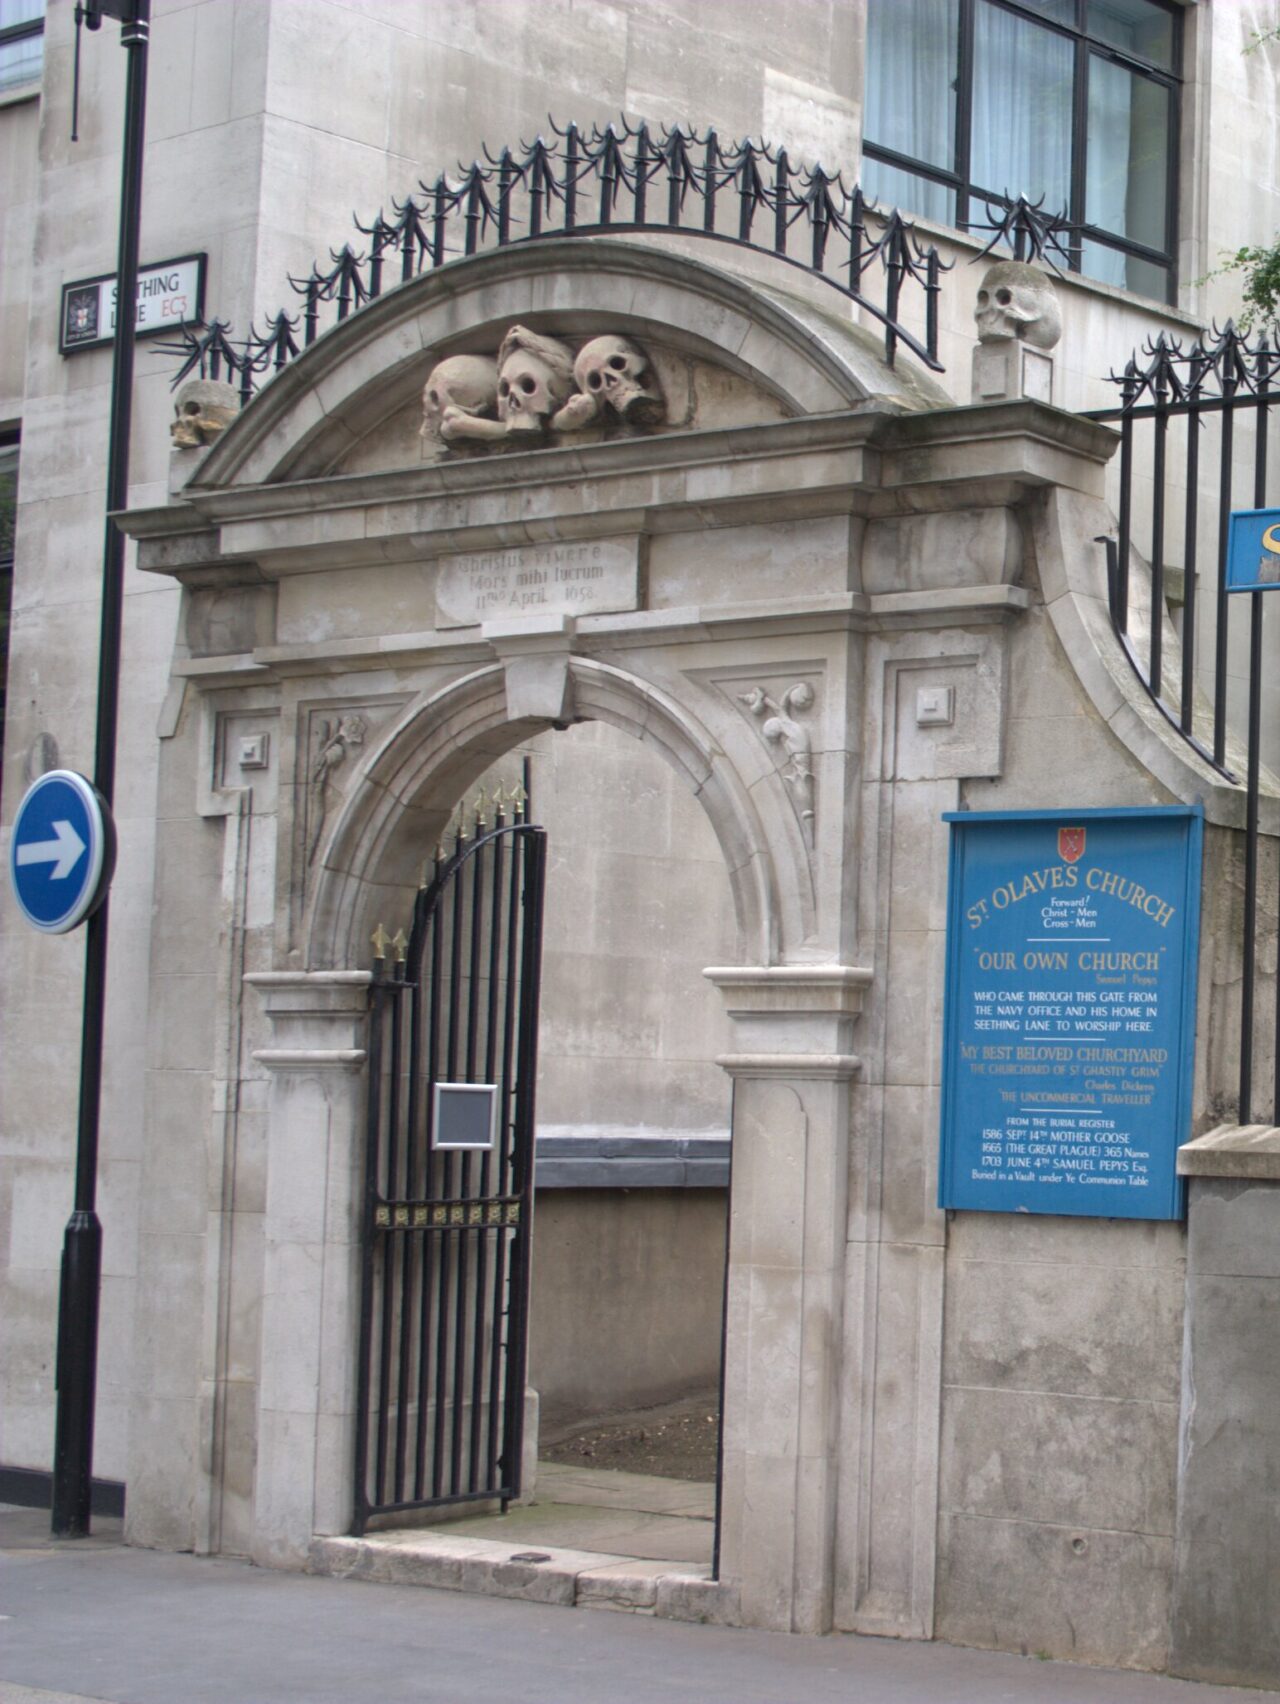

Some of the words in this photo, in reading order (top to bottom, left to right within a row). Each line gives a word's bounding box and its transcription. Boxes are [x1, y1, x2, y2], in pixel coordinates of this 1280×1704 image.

[112, 273, 179, 304] STHING
[111, 304, 146, 329] LE
[162, 296, 187, 318] EC3
[516, 569, 548, 586] mihi
[992, 863, 1079, 909] OLAVE'S
[1086, 867, 1176, 927] CHURCH
[1051, 895, 1090, 908] Forward!
[1024, 952, 1068, 970] OWN
[974, 991, 996, 1001] WHO
[998, 991, 1024, 1001] CAME
[1029, 991, 1073, 1002] THROUGH
[1076, 992, 1096, 1002] THIS
[1100, 992, 1124, 1002] GATE
[1128, 992, 1157, 1002] FROM
[975, 1005, 993, 1015] THE
[997, 1005, 1023, 1016] NAVY
[1028, 1006, 1062, 1016] OFFICE
[1065, 1006, 1086, 1016] AND
[1091, 1006, 1107, 1017] HIS
[1112, 1006, 1142, 1017] HOME
[1146, 1007, 1157, 1017] IN
[974, 1020, 1020, 1031] SEETHING
[1025, 1020, 1050, 1031] LANE
[1057, 1021, 1070, 1031] TO
[1075, 1021, 1121, 1032] WORSHIP
[983, 1045, 1013, 1060] BEST
[1016, 1046, 1073, 1061] BELOVED
[1077, 1047, 1168, 1063] CHURCHYARD
[970, 1063, 985, 1074] THE
[1053, 1064, 1066, 1075] OF
[1006, 1117, 1029, 1126] FROM
[1033, 1118, 1046, 1127] THE
[1050, 1119, 1076, 1128] BURIAL
[1079, 1119, 1115, 1129] REGISTER
[982, 1129, 1002, 1139] 1586
[1051, 1132, 1091, 1143] MOTHER
[1094, 1133, 1130, 1144] GOOSE
[982, 1142, 1001, 1153] 1665
[1028, 1144, 1056, 1155] GREAT
[1104, 1146, 1122, 1157] 365
[982, 1155, 1001, 1166] 1703
[1007, 1157, 1031, 1167] JUNE
[1053, 1159, 1095, 1170] SAMUEL
[1100, 1161, 1128, 1172] PEPYS
[972, 1169, 996, 1180] Buried
[1014, 1171, 1035, 1181] Vault
[1039, 1173, 1062, 1183] under
[1065, 1174, 1075, 1183] Ye
[1079, 1174, 1126, 1185] Communion
[1129, 1175, 1149, 1186] Table
